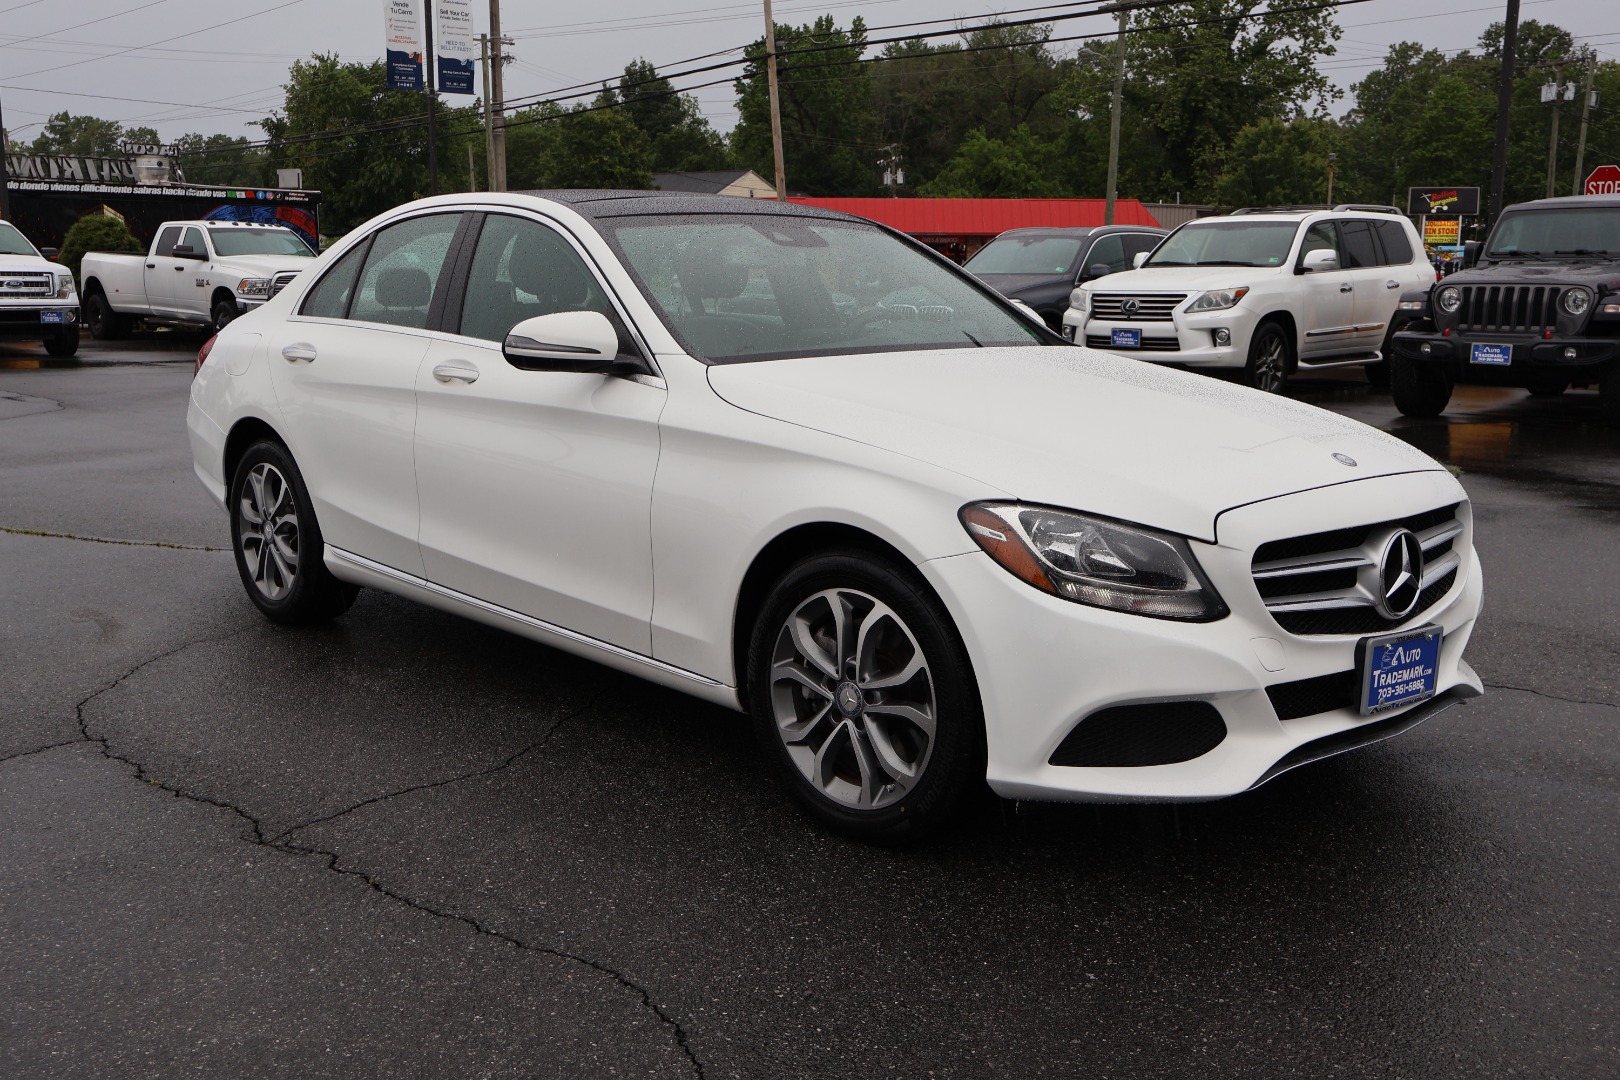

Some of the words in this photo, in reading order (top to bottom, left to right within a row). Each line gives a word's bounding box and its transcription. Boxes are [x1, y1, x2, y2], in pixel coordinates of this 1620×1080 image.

[7, 181, 19, 190] de
[20, 182, 49, 191] donde
[50, 183, 80, 192] vienes
[80, 184, 132, 194] dificilmente
[133, 186, 161, 195] sabras
[162, 187, 185, 196] hacia
[186, 188, 212, 198] donde
[213, 190, 226, 199] vas
[1431, 190, 1457, 200] Rolling
[1429, 196, 1458, 208] Bargains
[1391, 646, 1421, 665] AUTO
[1378, 679, 1425, 700] 703-361-6882
